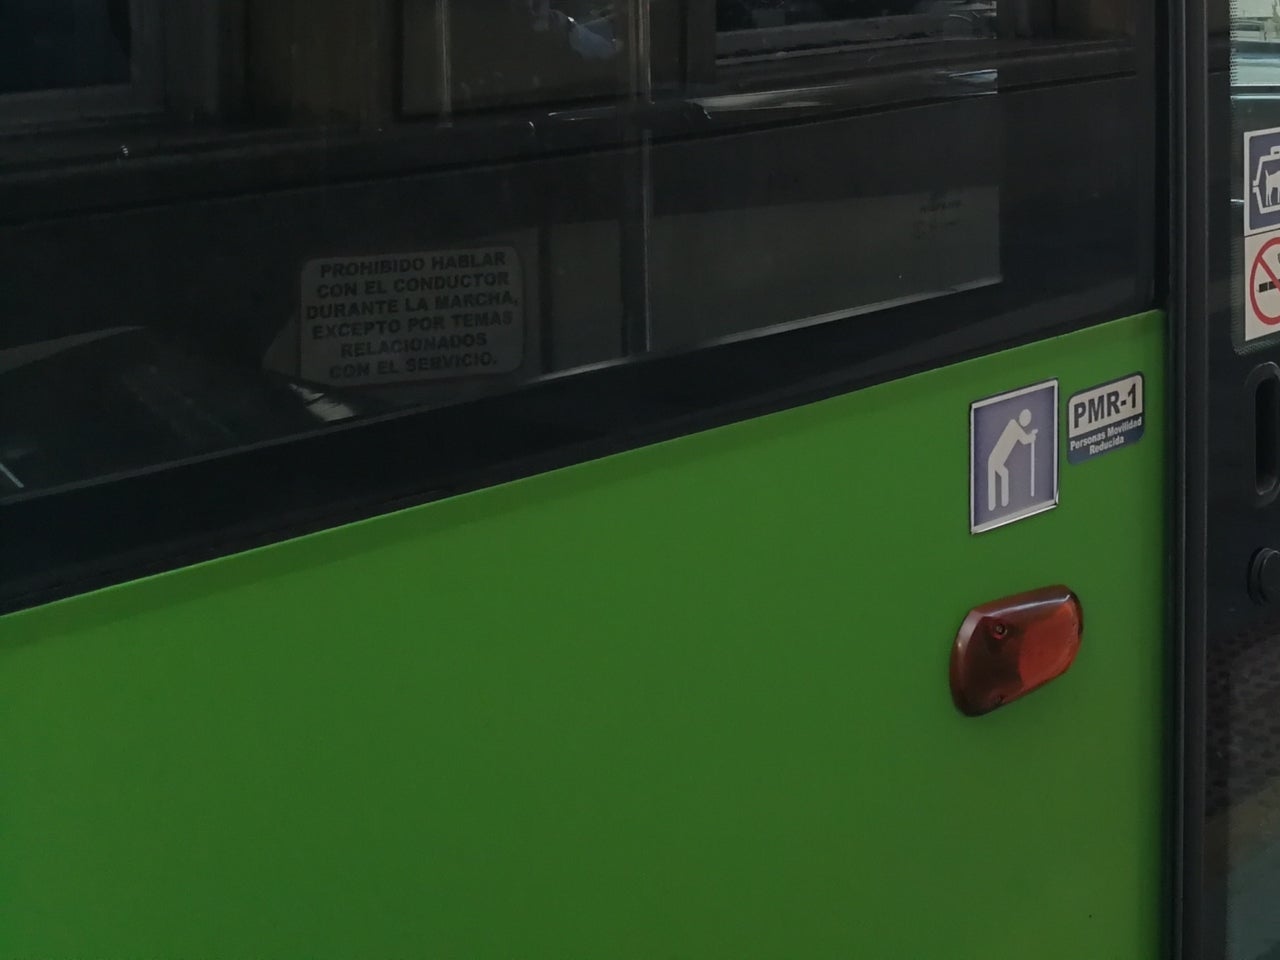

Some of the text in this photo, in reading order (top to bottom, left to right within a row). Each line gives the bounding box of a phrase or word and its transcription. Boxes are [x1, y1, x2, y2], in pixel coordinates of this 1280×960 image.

[320, 251, 506, 278] PROHIBIDO HABLAR
[316, 272, 509, 299] CON EL CONDUCTOR
[307, 299, 398, 320] DURANTE
[405, 297, 428, 313] LA
[312, 310, 513, 339] EXCEPTO POR TEMAS
[340, 332, 487, 358] RELACIONADOS
[329, 363, 370, 379] CON
[377, 359, 399, 374] EL
[1073, 383, 1137, 429] PMR-1
[1070, 416, 1142, 451] Personas Movilidad
[1089, 436, 1125, 455] Reducida
